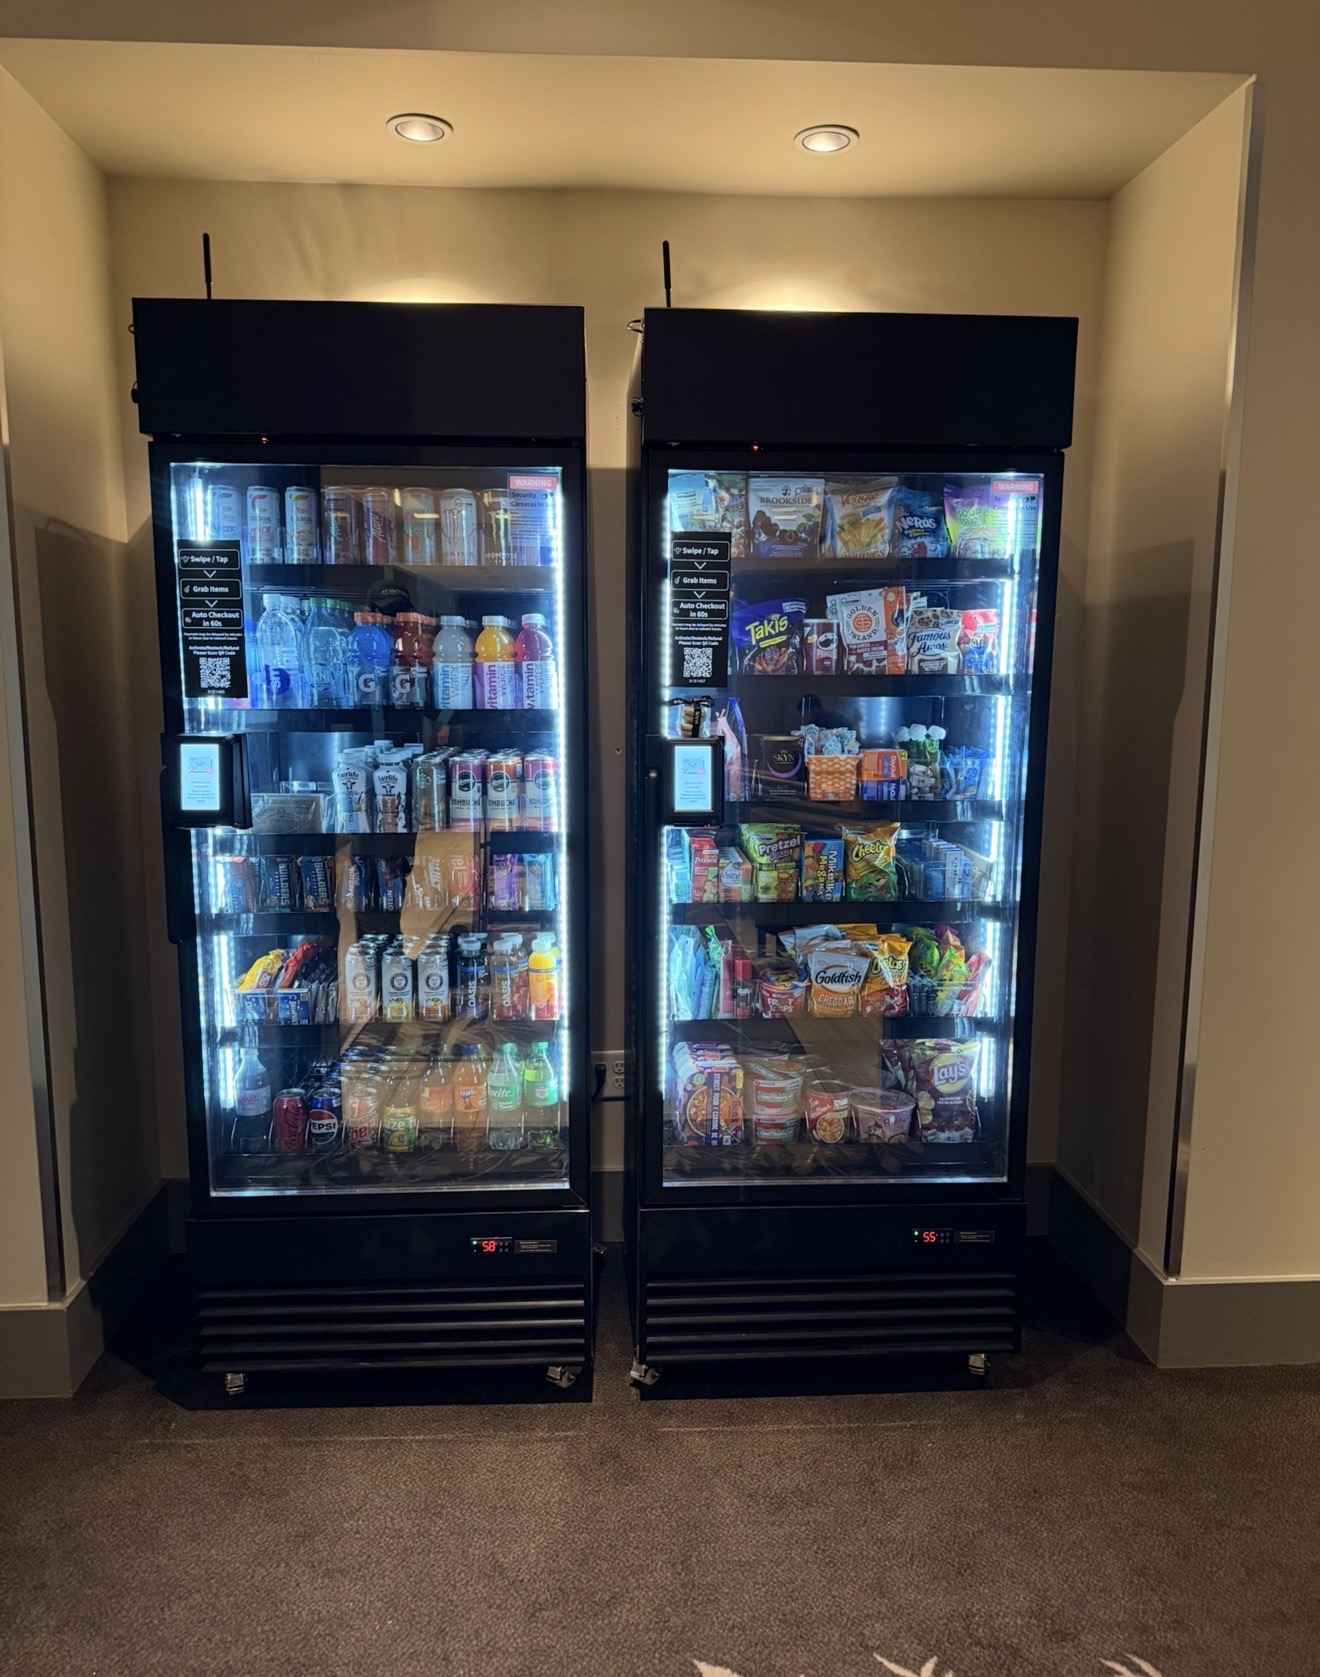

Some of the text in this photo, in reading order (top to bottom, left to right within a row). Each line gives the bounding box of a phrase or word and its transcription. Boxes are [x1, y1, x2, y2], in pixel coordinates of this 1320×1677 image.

[514, 478, 552, 487] WARNING
[998, 483, 1034, 491] WARNING
[760, 496, 812, 505] BROOKSIDE
[841, 491, 879, 508] Veggie
[682, 547, 702, 555] Swipe
[190, 556, 210, 564] Swipe
[216, 556, 228, 564] Tap
[847, 604, 879, 620] GOLDEN
[745, 614, 788, 645] Takis
[849, 628, 878, 641] ISLAND
[908, 630, 951, 649] Famous
[912, 642, 948, 658] Amos
[440, 664, 450, 710] vitamin
[486, 664, 497, 710] vitamin
[524, 662, 535, 710] vitamin
[772, 754, 794, 762] SKYN
[758, 834, 800, 856] Pretzel
[817, 856, 828, 882] Mega
[827, 850, 838, 880] Mike
[279, 863, 291, 906] BUILDERS
[314, 860, 328, 905] BUILDERS
[814, 970, 862, 985] Goldfish
[468, 980, 476, 1008] OASIS
[502, 980, 512, 1008] OASIS
[818, 994, 855, 1006] CHEDDAR
[934, 1062, 967, 1086] Lay's
[730, 1100, 741, 1123] Ben's
[312, 1122, 336, 1131] EPSI
[384, 1120, 406, 1130] uze
[923, 1231, 936, 1242] 55
[482, 1240, 496, 1252] 58
